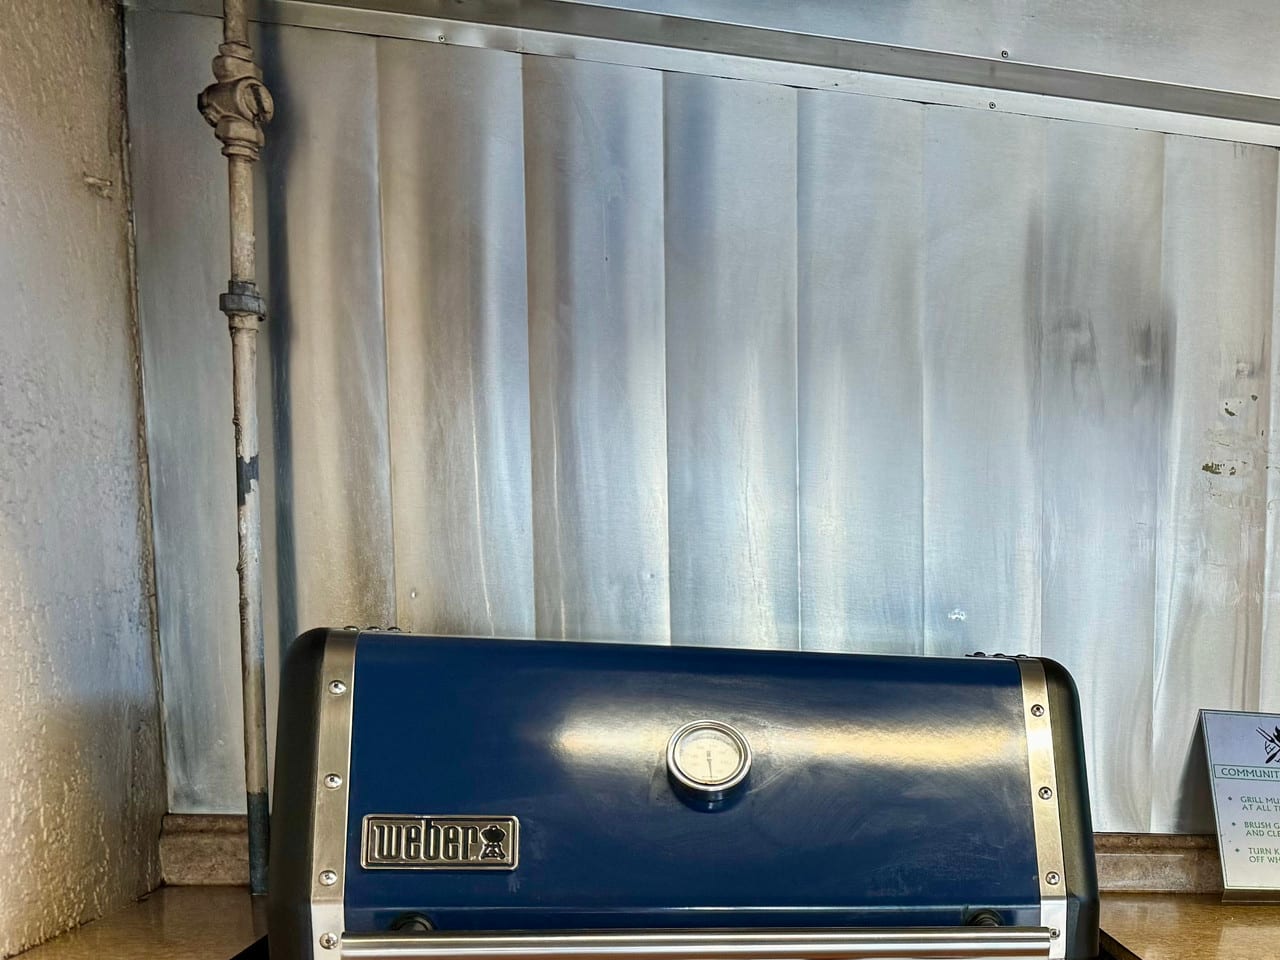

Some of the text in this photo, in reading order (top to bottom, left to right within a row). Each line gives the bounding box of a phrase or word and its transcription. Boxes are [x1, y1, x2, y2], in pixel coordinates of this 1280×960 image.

[1240, 796, 1263, 804] GRILL
[1244, 821, 1272, 829] BRUSH
[374, 819, 479, 860] weber
[1248, 847, 1272, 855] TURN
[1249, 855, 1265, 863] OFF
